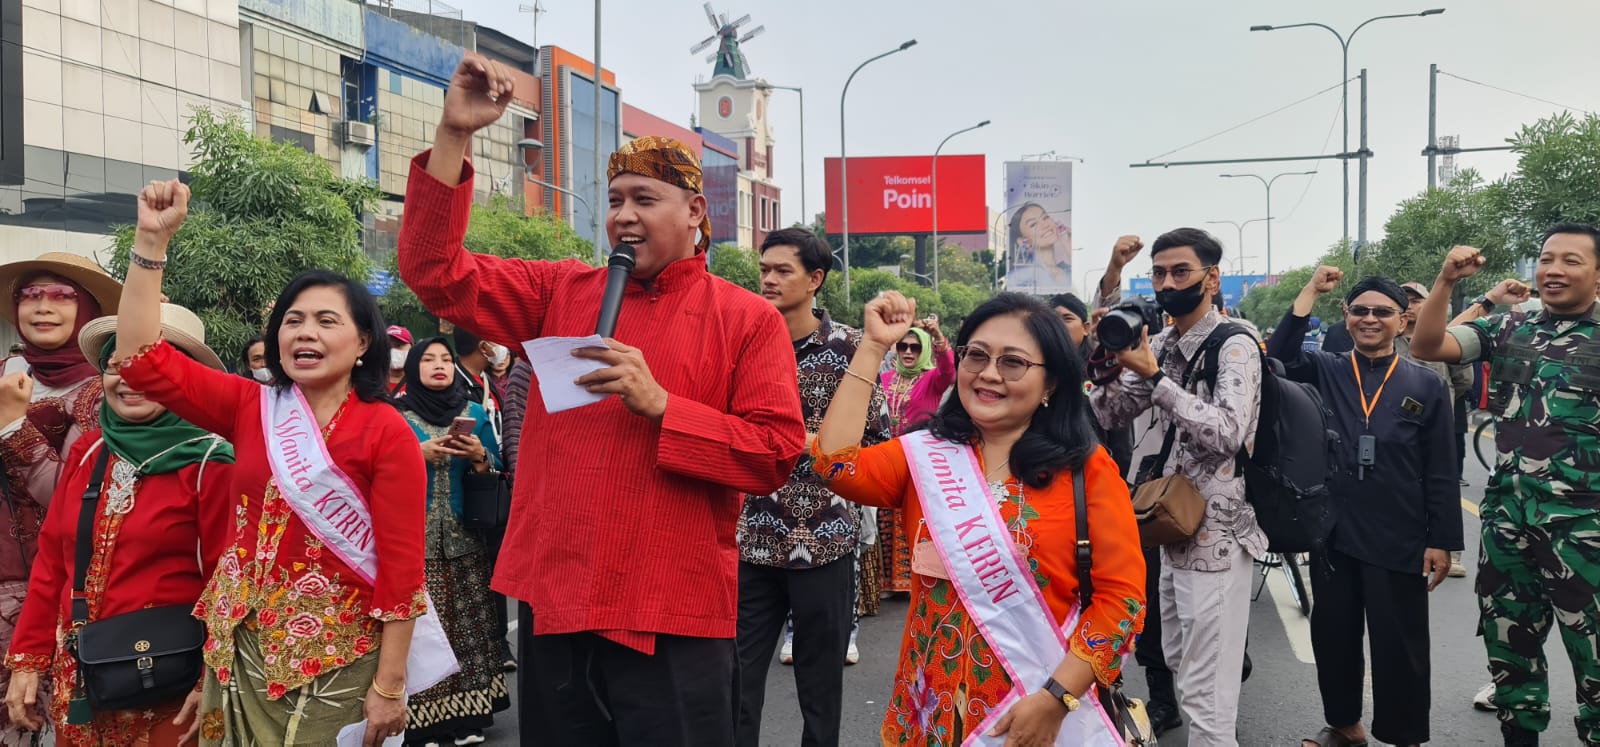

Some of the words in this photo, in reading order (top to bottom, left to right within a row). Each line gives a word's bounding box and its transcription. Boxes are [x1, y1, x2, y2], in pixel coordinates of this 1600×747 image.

[883, 175, 931, 185] Telkomsel
[883, 188, 931, 209] Poin
[274, 409, 315, 493] Wanita
[312, 488, 375, 552] KEREN
[954, 514, 1019, 605] KEREN
